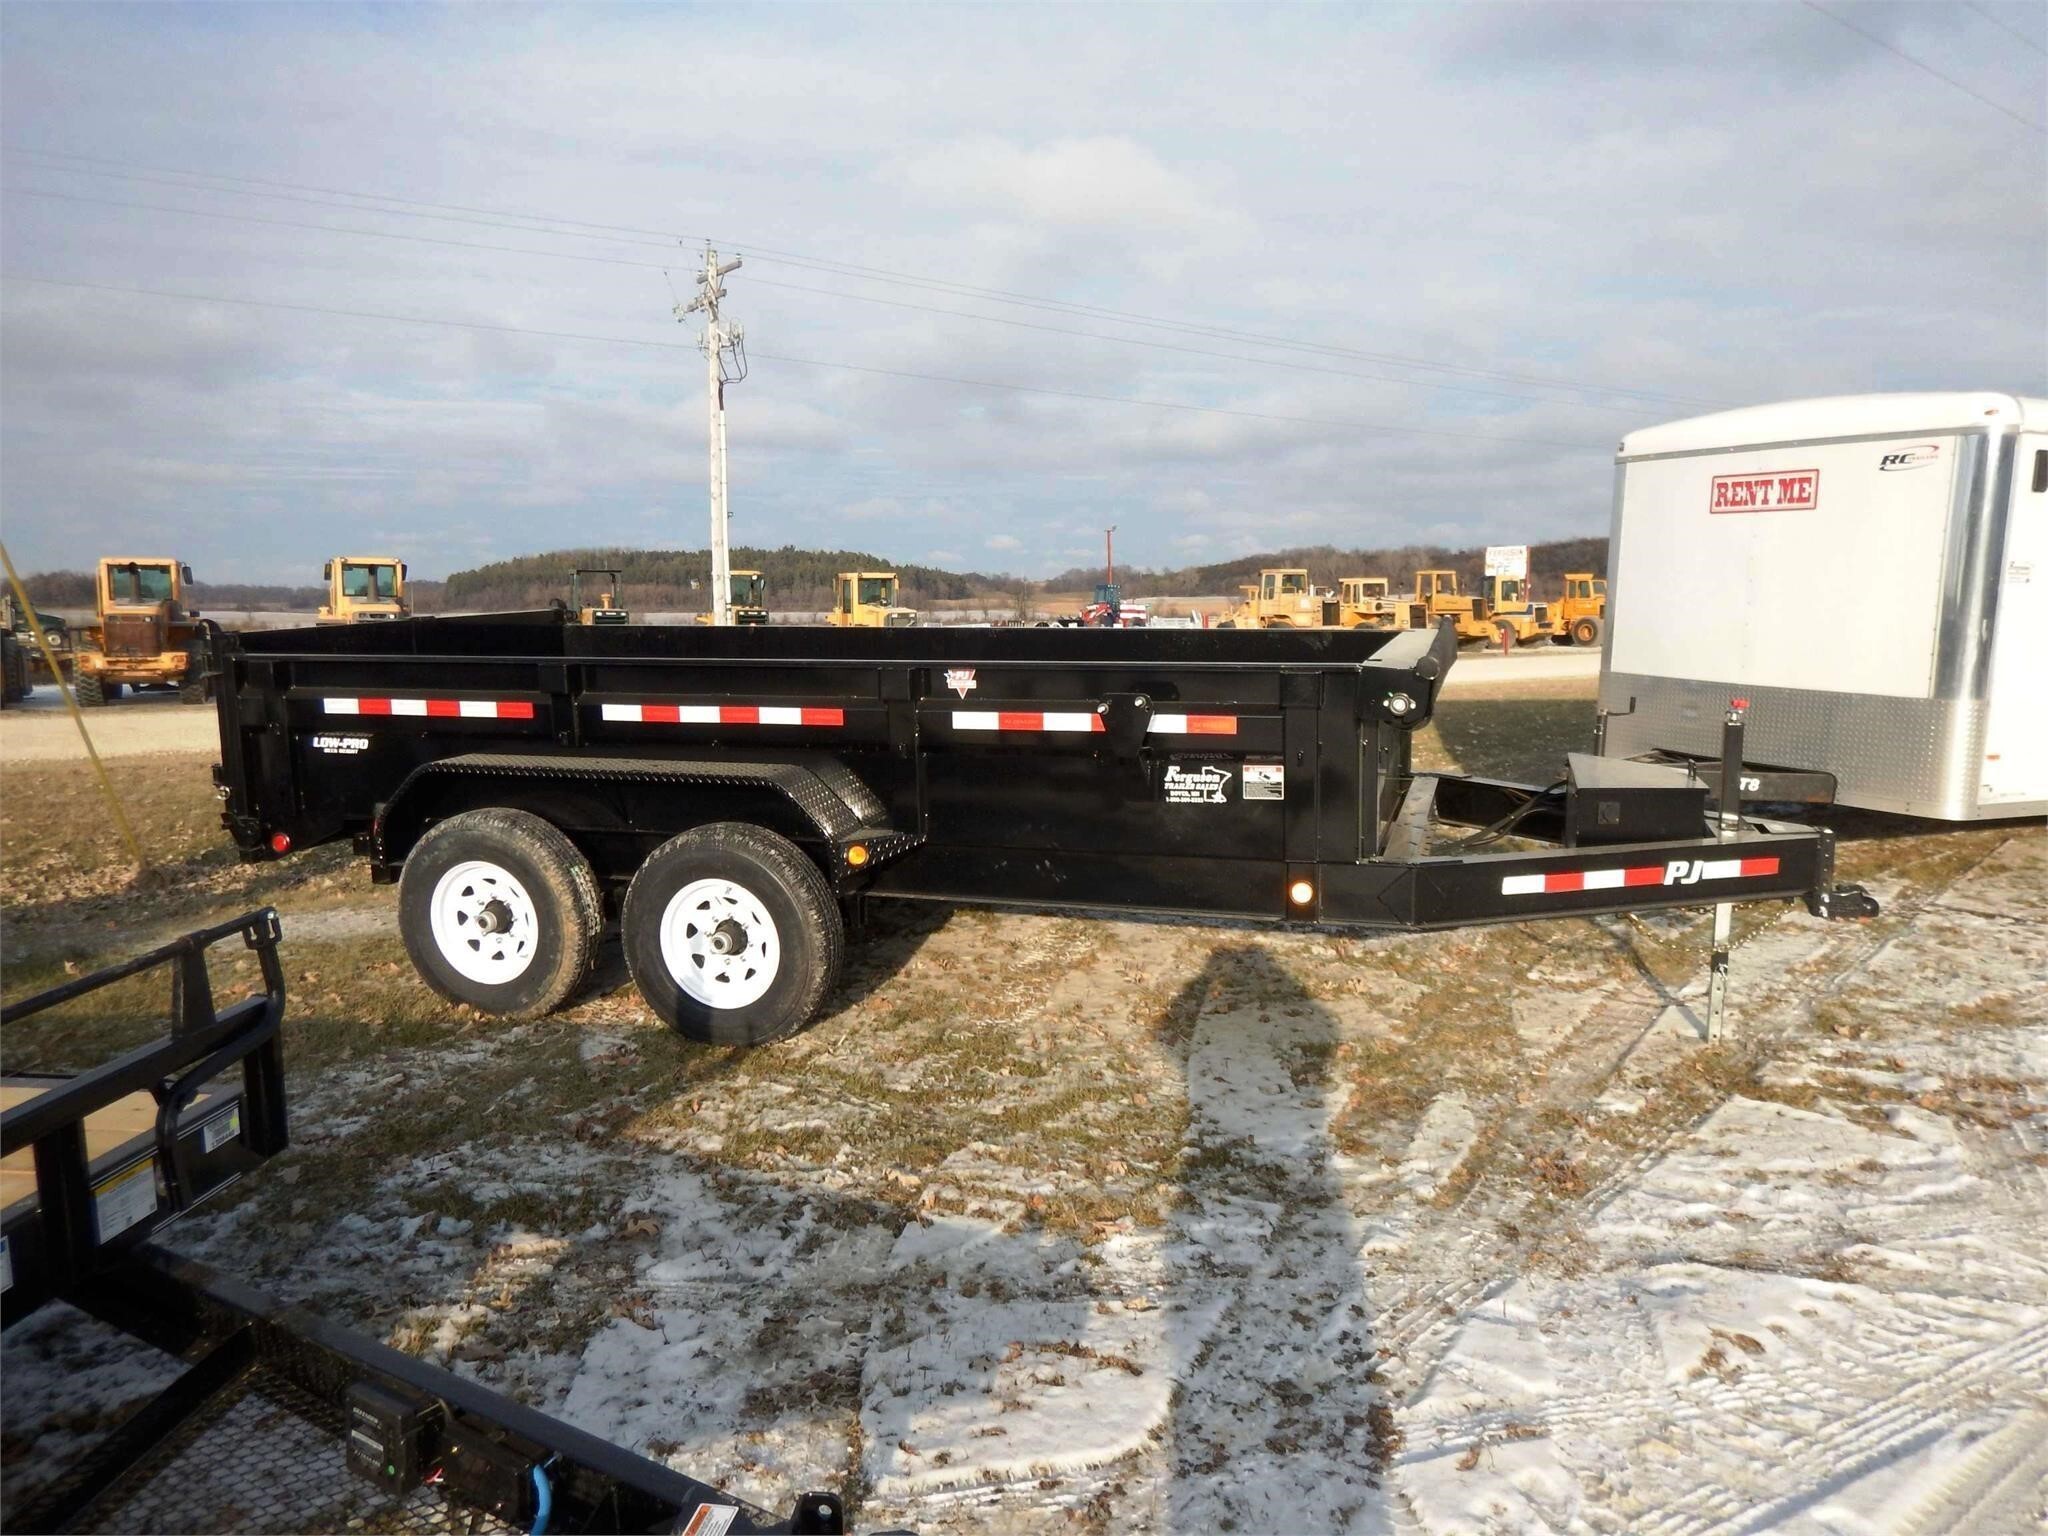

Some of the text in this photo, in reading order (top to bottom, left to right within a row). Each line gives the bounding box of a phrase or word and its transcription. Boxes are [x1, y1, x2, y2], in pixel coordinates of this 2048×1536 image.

[1880, 453, 1916, 466] RC
[1715, 477, 1812, 507] RENT ME
[313, 736, 369, 750] LOW-PRO
[1164, 766, 1221, 787] Ferguson
[1164, 782, 1219, 791] TRAILER SALES
[1663, 860, 1704, 885] PJ
